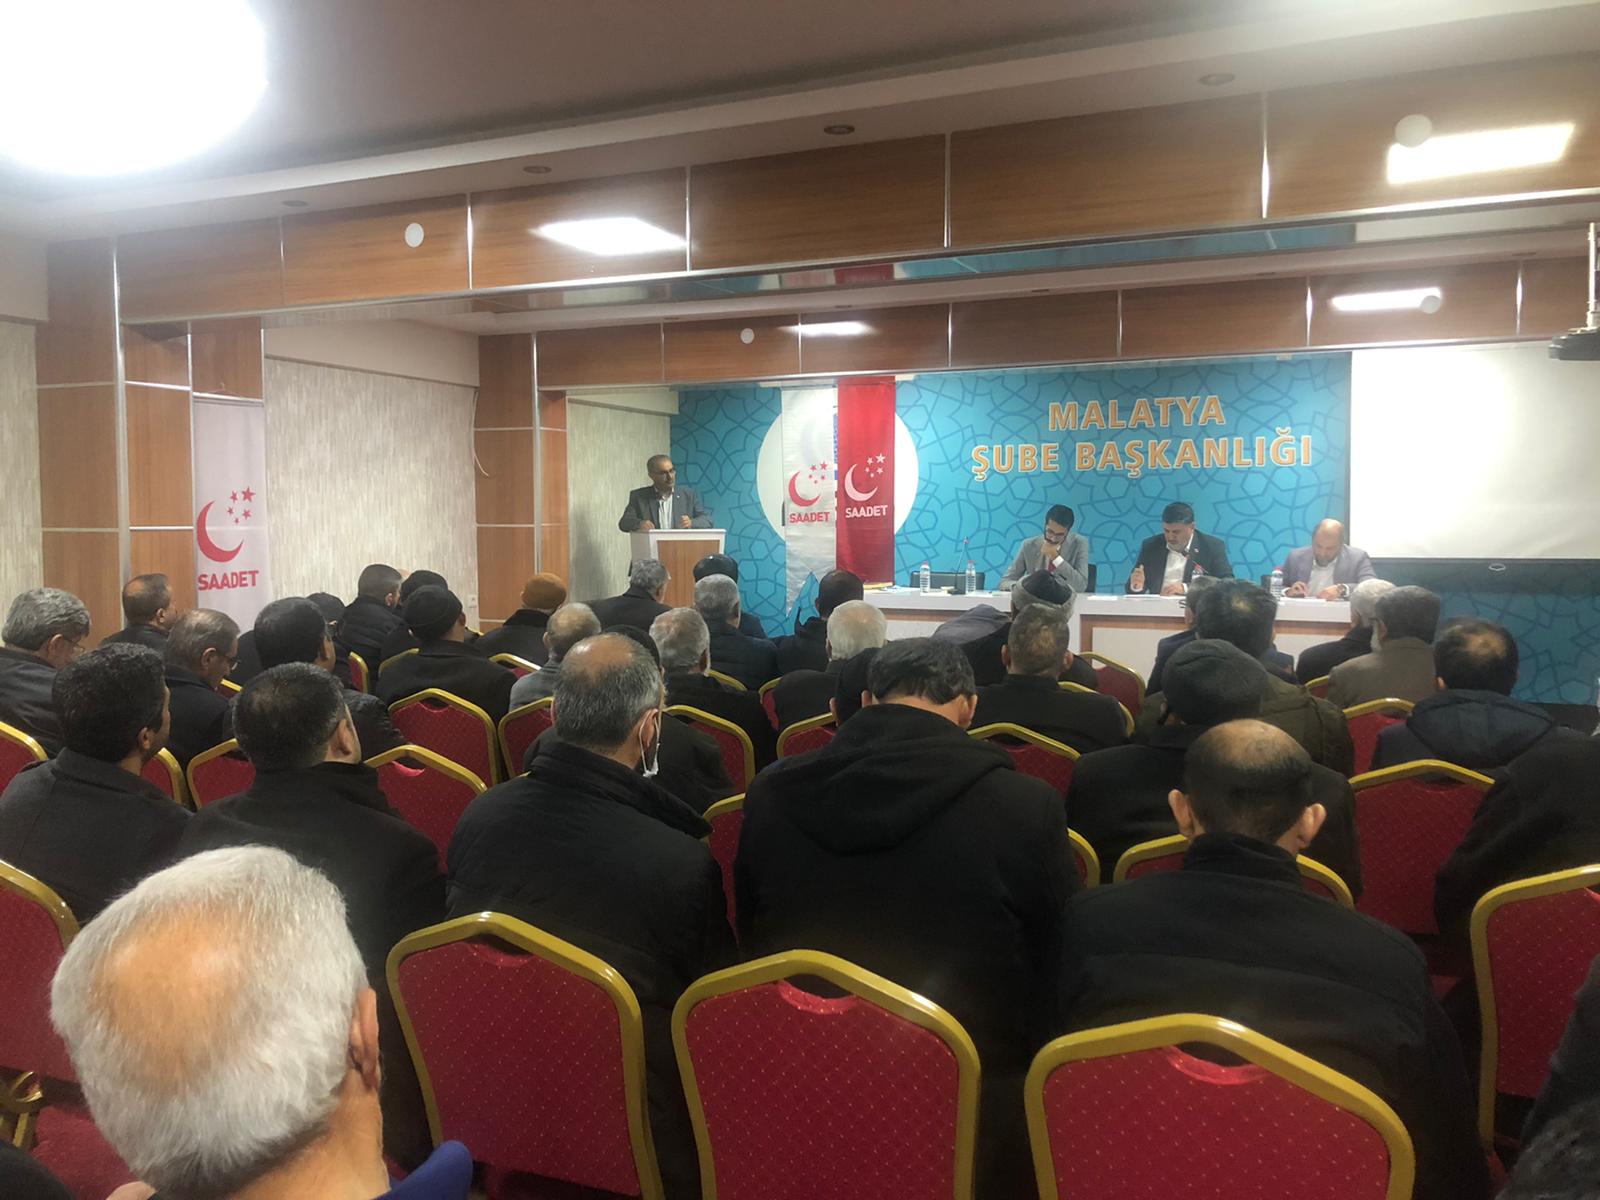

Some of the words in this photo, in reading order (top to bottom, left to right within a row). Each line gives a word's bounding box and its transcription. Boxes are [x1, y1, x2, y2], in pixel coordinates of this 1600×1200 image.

[1048, 394, 1226, 431] MALATYA
[971, 443, 1059, 482] ŞUBE
[1075, 426, 1312, 478] BAŞKANLIĞI
[789, 511, 830, 523] SAADET
[845, 504, 888, 518] SAADET
[197, 570, 259, 591] SAADET
